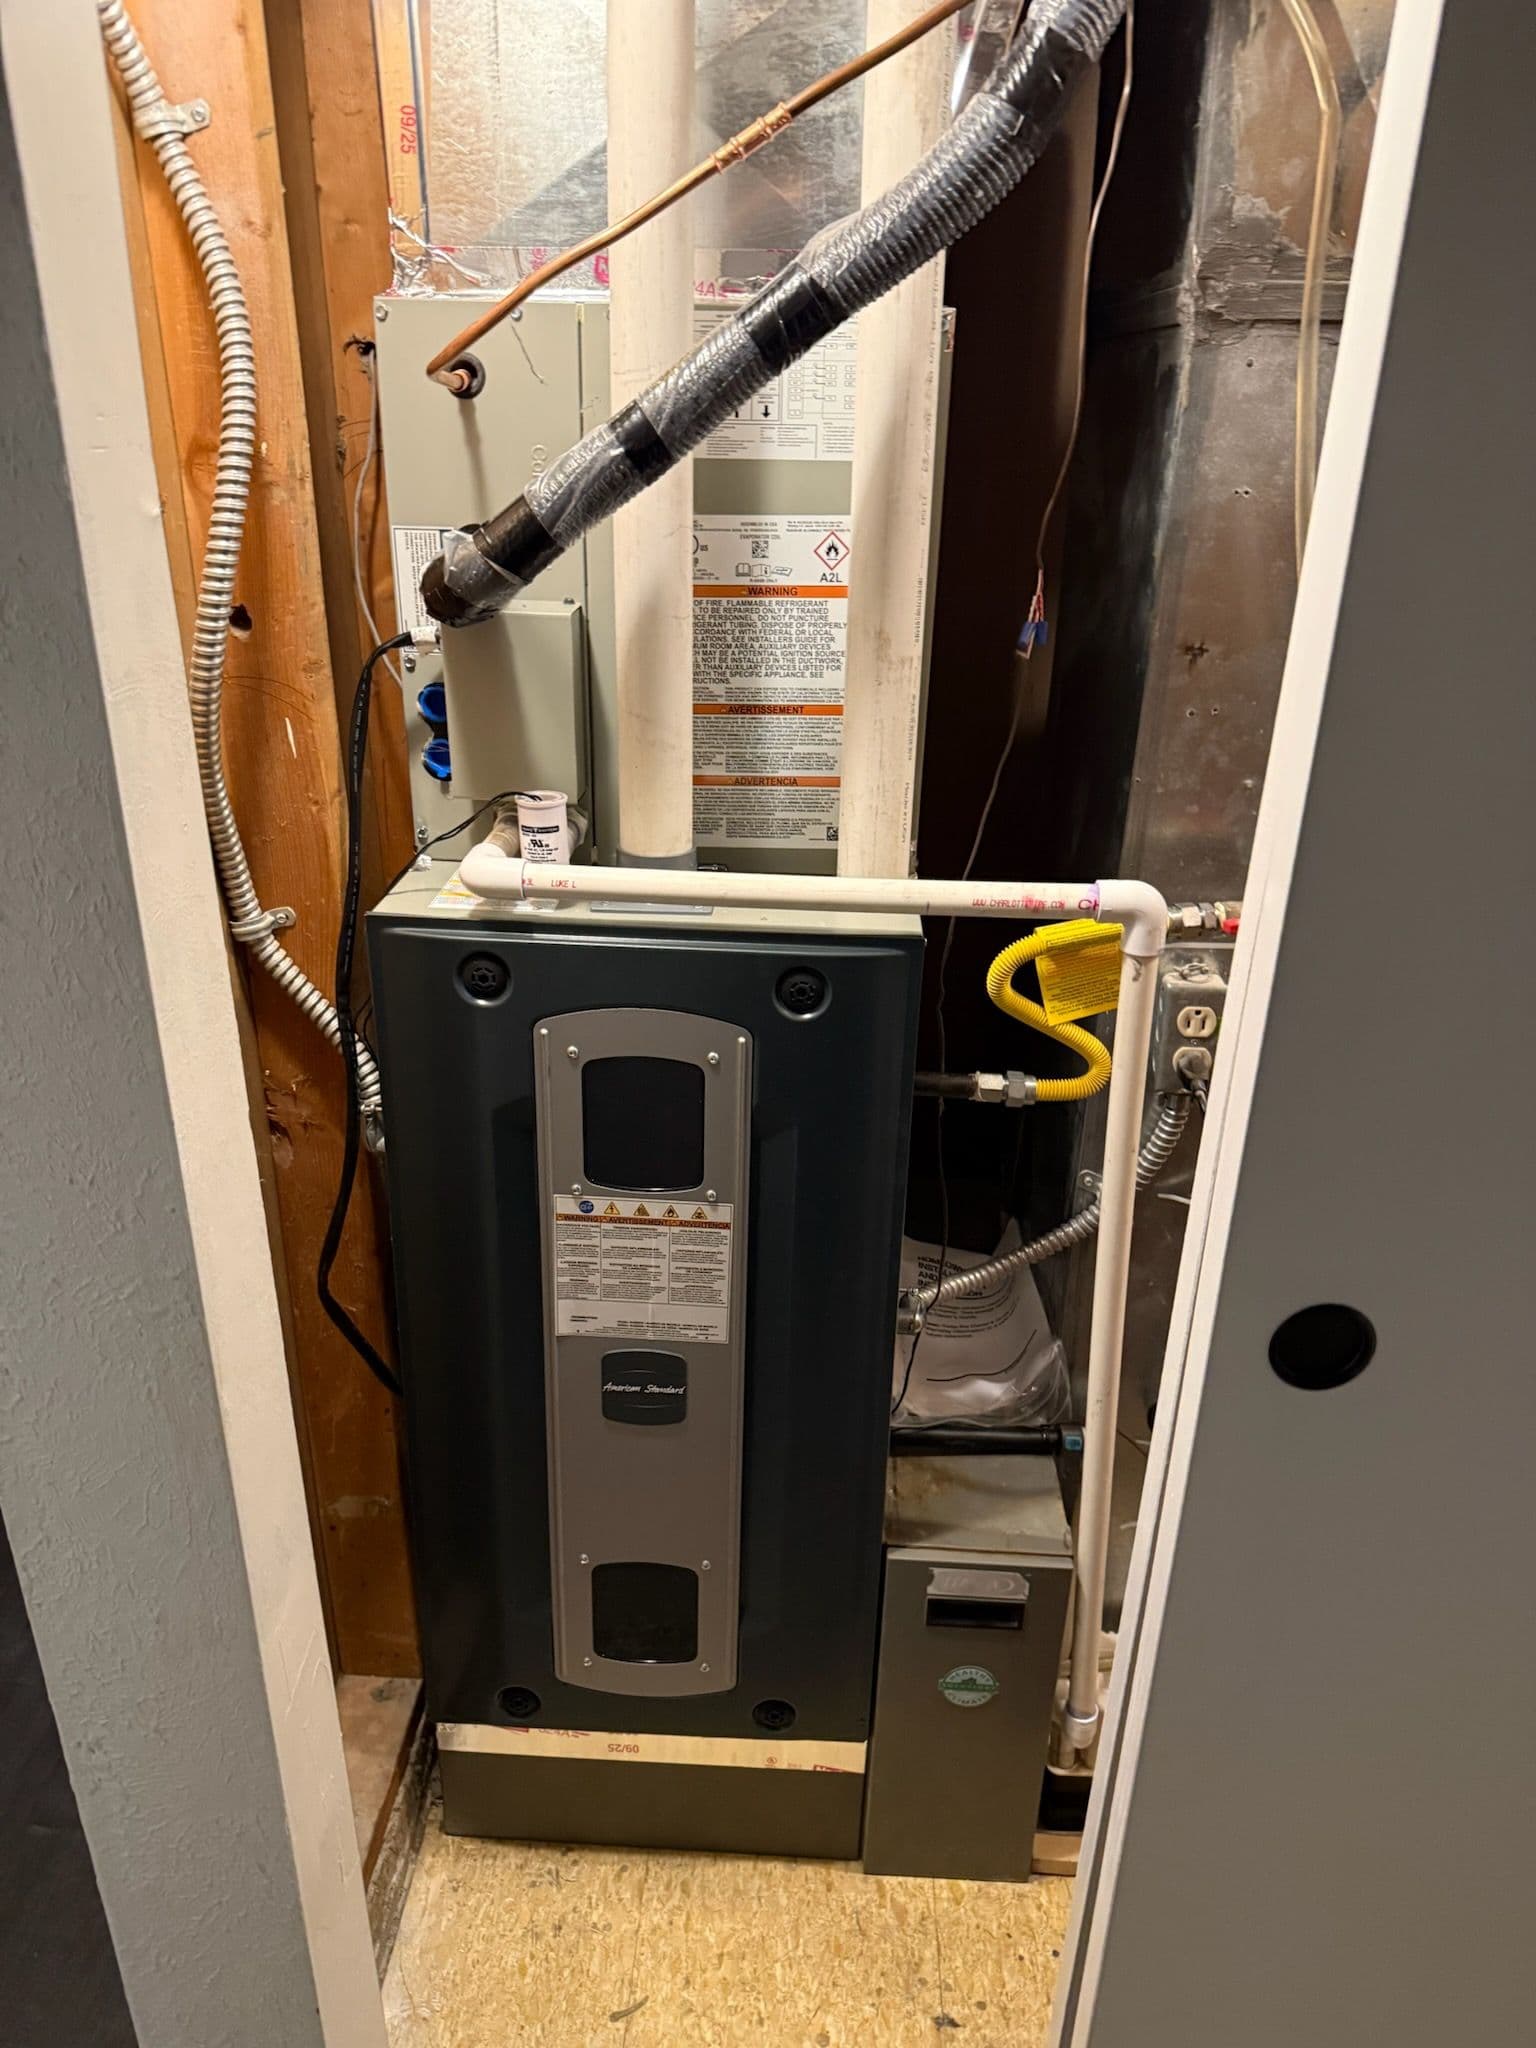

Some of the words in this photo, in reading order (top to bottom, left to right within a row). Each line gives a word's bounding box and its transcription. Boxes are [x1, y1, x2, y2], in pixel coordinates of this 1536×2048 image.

[400, 104, 417, 155] 09/25
[820, 573, 843, 583] A2L
[748, 587, 798, 596] WARNING
[728, 706, 804, 715] AVERTISSEMENT
[735, 777, 799, 786] ADVERTENCIA
[563, 1214, 597, 1223] WARNING
[609, 1217, 668, 1227] AVERTISSEMENT
[679, 1221, 731, 1230] ADVERTENCIA
[602, 1382, 642, 1393] American
[644, 1384, 687, 1394] Standard
[607, 1743, 640, 1754] 09/25
